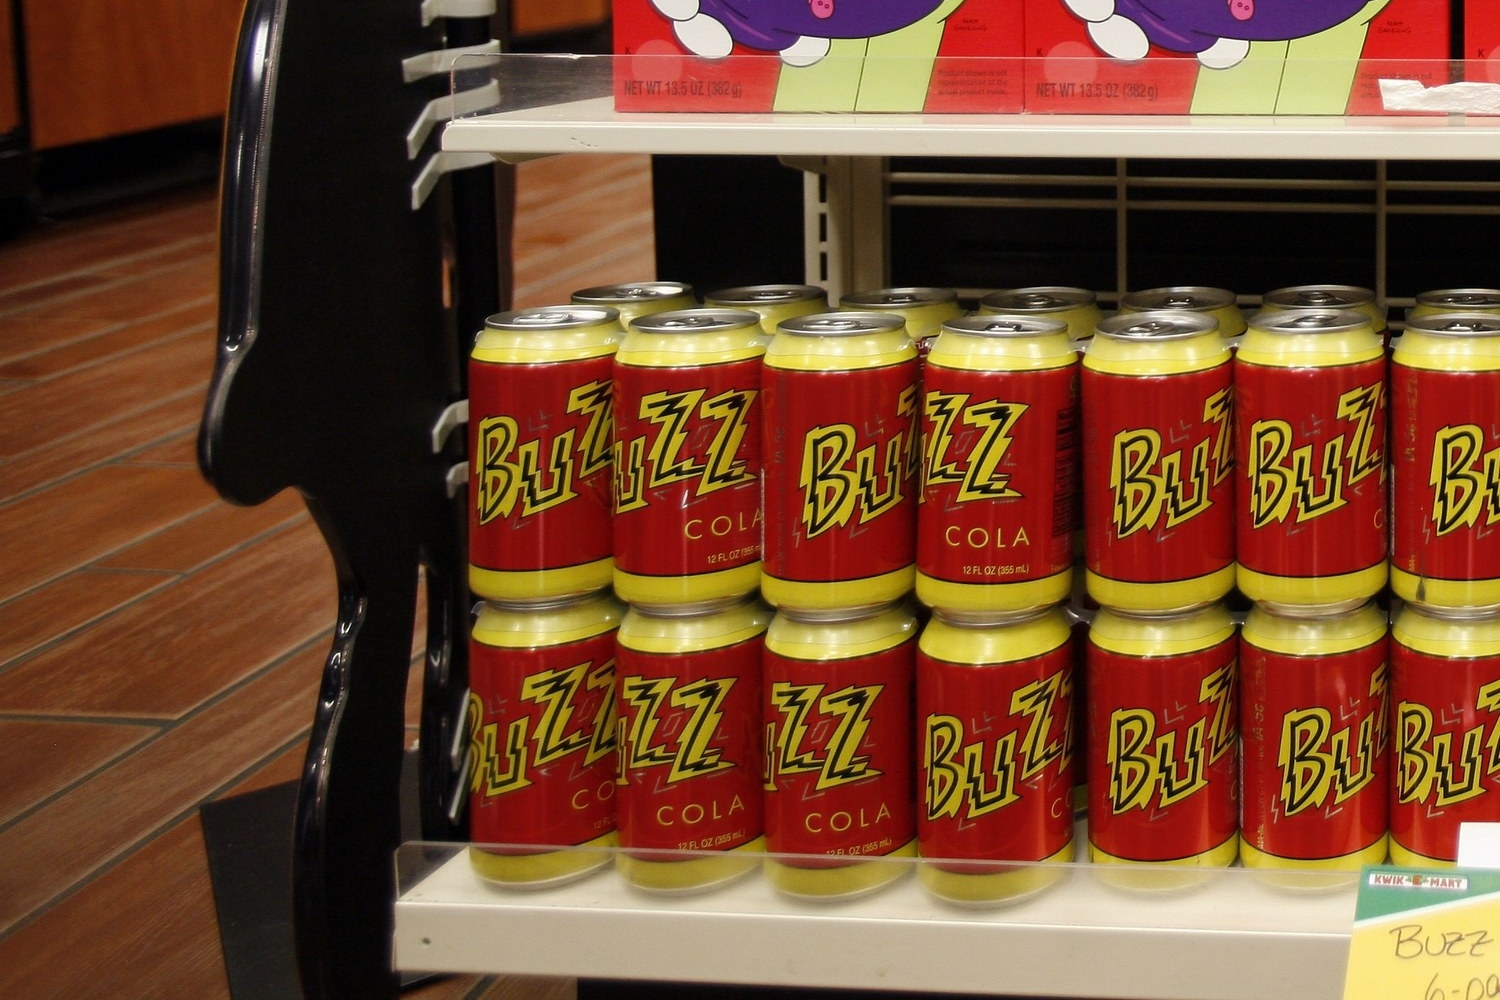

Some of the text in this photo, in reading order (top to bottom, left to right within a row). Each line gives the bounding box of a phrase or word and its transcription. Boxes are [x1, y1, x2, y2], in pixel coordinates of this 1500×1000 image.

[1249, 380, 1388, 531] BUZ
[684, 507, 762, 540] COLA
[945, 526, 1030, 548] COLA
[924, 669, 1073, 821] BUZ
[657, 794, 745, 826] COLA
[805, 802, 891, 833] COLA
